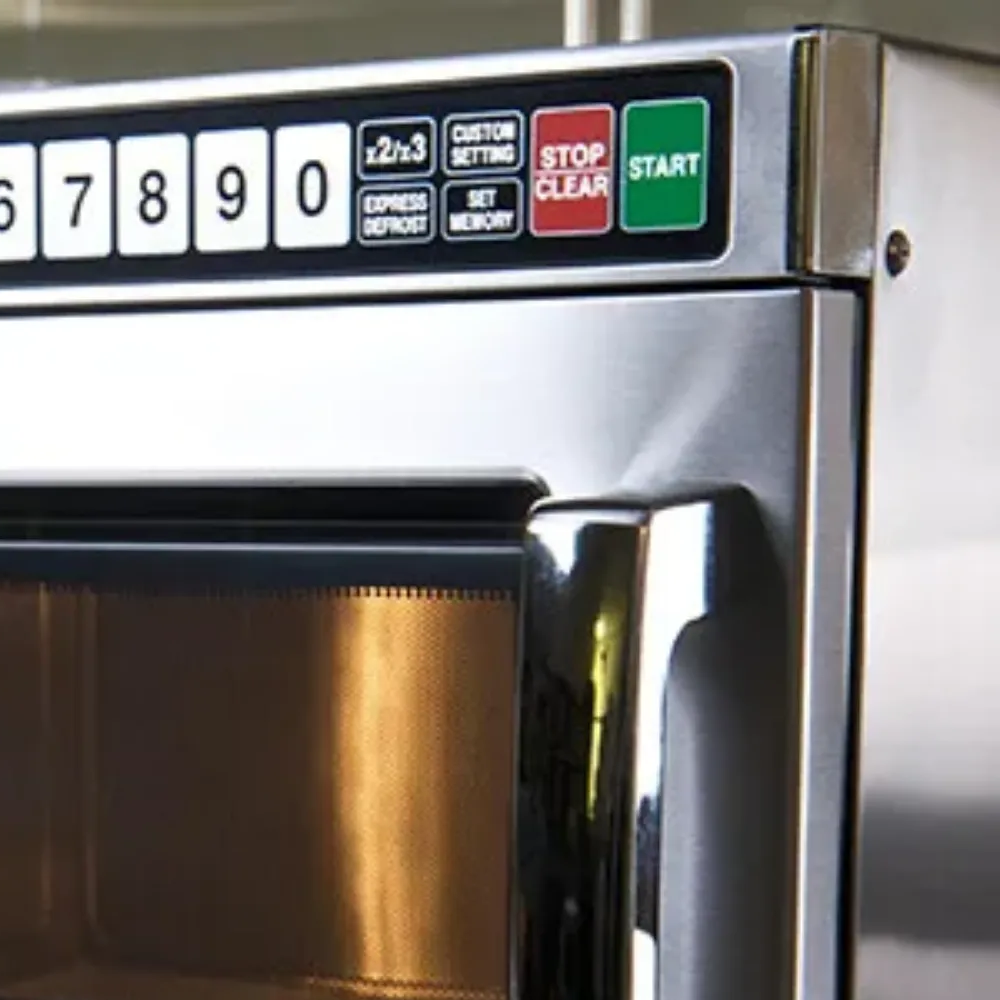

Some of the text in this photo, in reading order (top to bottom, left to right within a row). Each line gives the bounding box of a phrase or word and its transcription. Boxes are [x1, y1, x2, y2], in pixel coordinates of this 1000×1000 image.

[450, 144, 516, 168] SETTING
[539, 143, 606, 170] STOP
[628, 152, 702, 181] START
[64, 174, 92, 228] 7
[138, 169, 167, 224] 8
[216, 165, 246, 221] 9
[297, 160, 327, 216] 0
[466, 187, 498, 209] SET
[535, 173, 609, 201] CLEAR
[449, 209, 514, 232] MEMORY
